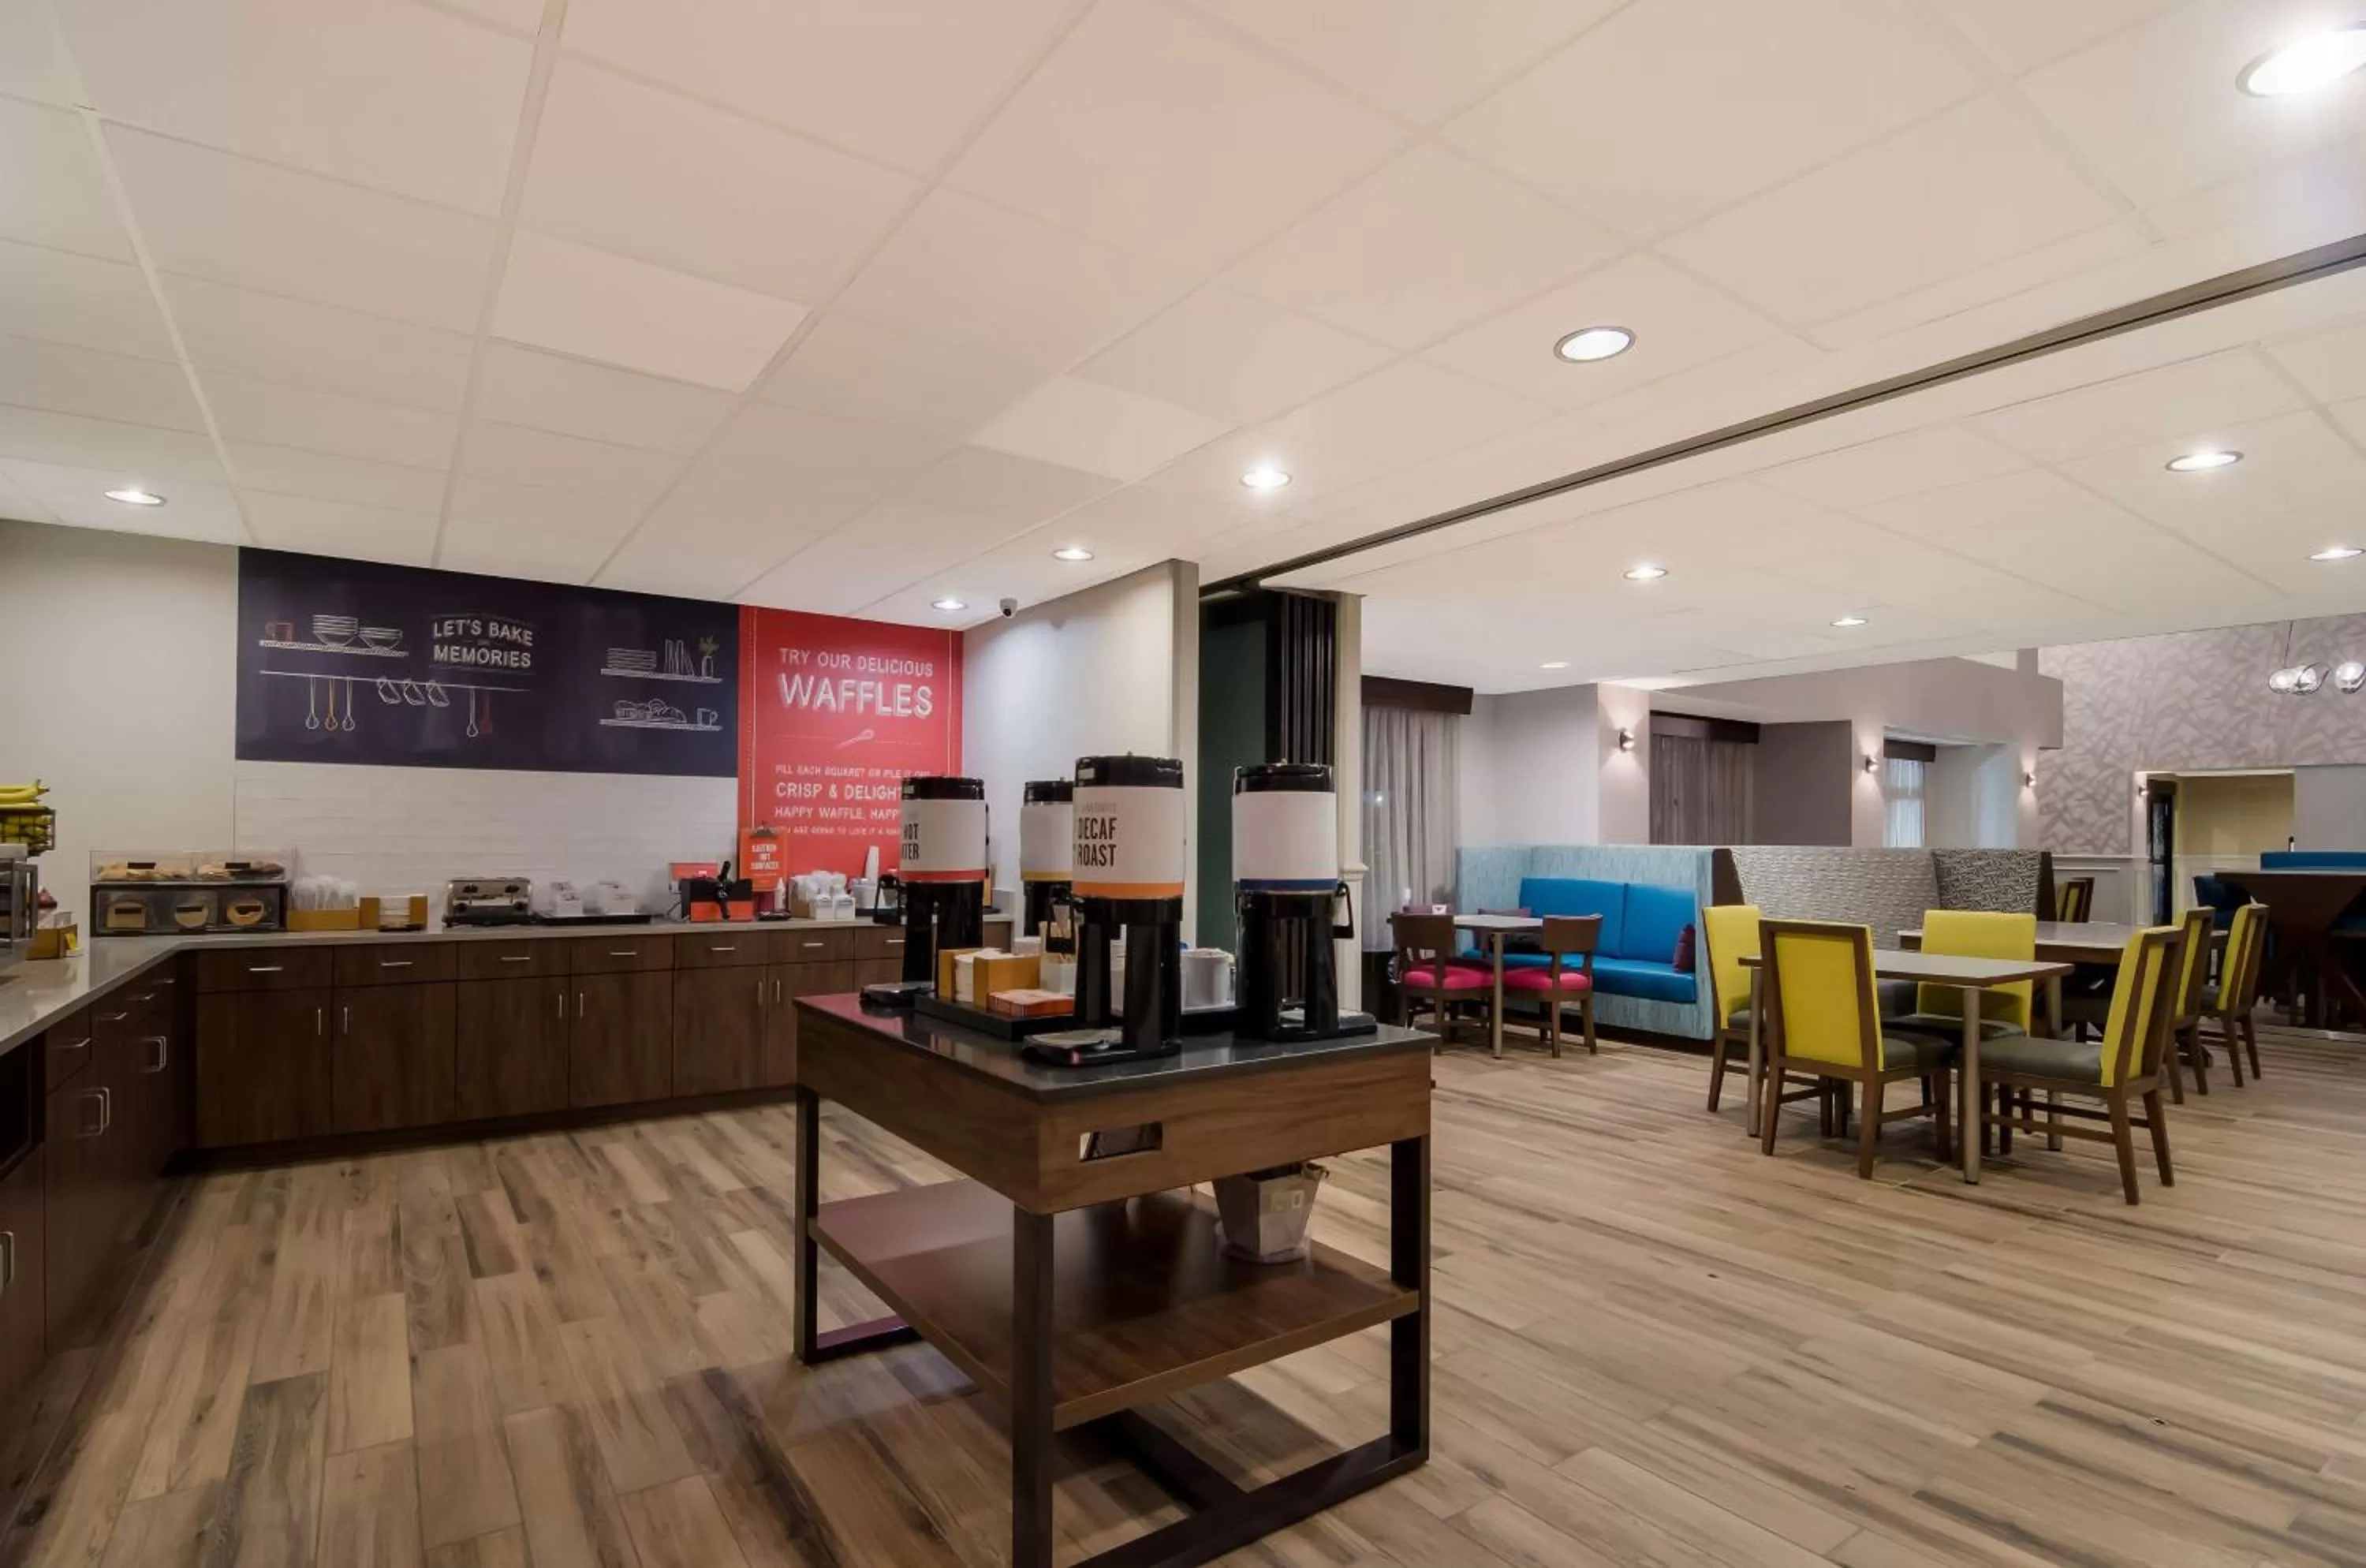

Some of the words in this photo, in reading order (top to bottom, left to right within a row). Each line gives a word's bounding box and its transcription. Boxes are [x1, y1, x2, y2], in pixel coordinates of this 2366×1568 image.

[433, 619, 482, 639] LET'S
[489, 622, 533, 647] BAKE
[434, 644, 532, 668] MEMORIES
[779, 648, 810, 665] TRY
[817, 651, 851, 670] OUR
[857, 655, 934, 678] DELICIOUS
[778, 672, 934, 719] WAFFLES
[776, 782, 822, 799] CRISP
[829, 782, 838, 800] &
[844, 784, 901, 801] DELIGHT
[774, 806, 813, 819] HAPPY
[870, 808, 901, 821] HAPP
[1077, 816, 1118, 841] DECAF
[901, 843, 919, 861] TER
[1077, 843, 1118, 868] ROAST
